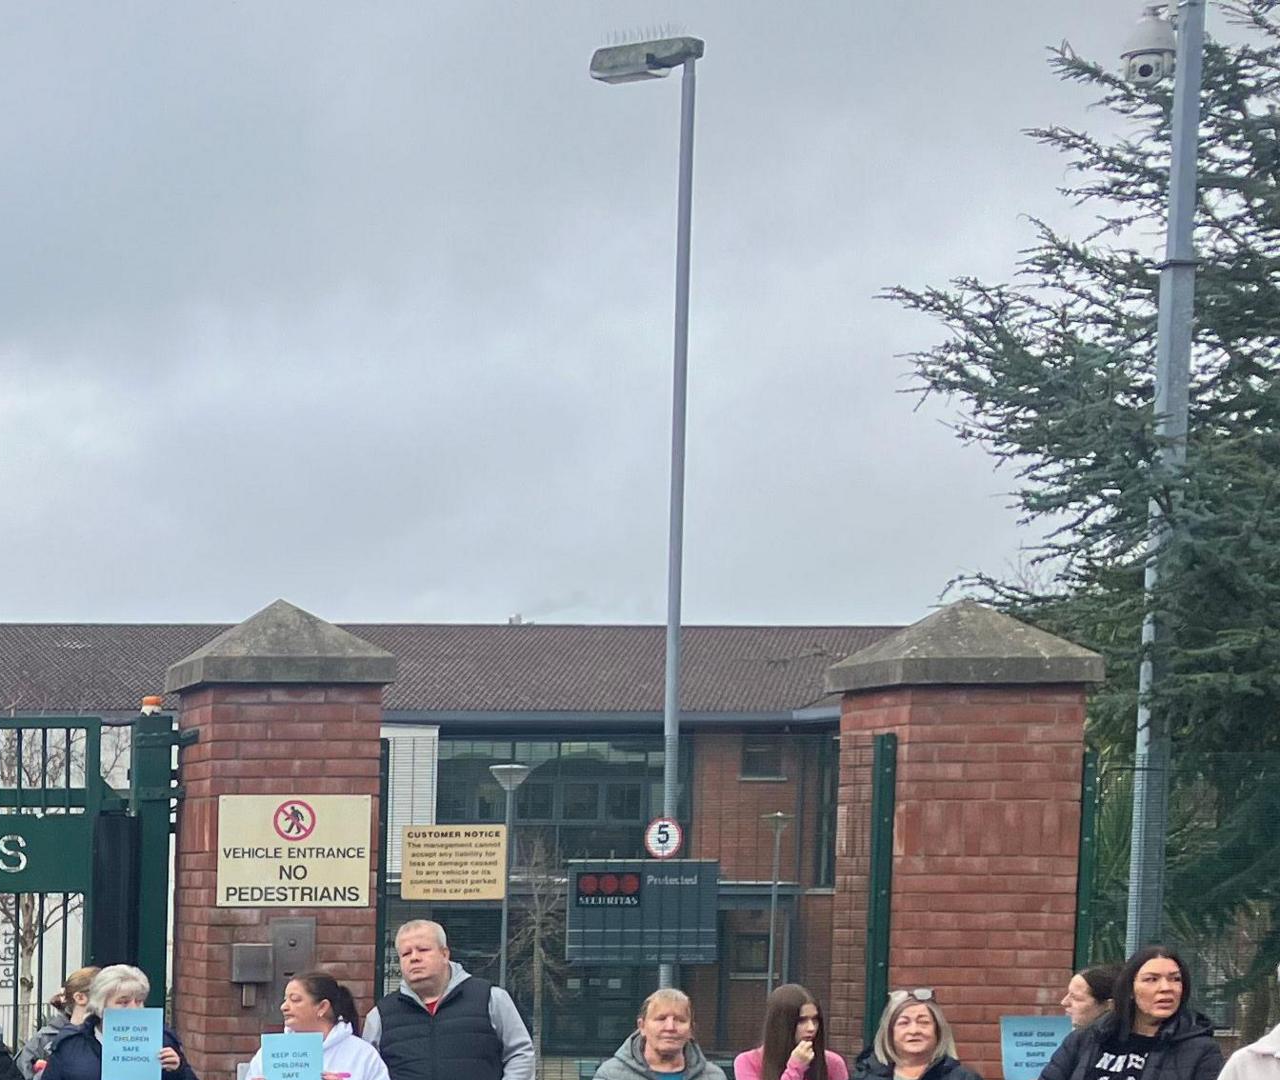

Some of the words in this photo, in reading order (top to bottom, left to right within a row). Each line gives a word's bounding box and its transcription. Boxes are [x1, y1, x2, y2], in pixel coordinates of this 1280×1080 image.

[464, 830, 500, 838] NOTICE
[657, 824, 670, 844] 5
[223, 847, 282, 859] VEHICLE
[288, 847, 365, 859] ENTRANCE
[279, 865, 307, 880] NO
[646, 875, 698, 885] Protected
[225, 886, 360, 902] PEDESTRIANS
[579, 895, 638, 905] SECURITAS
